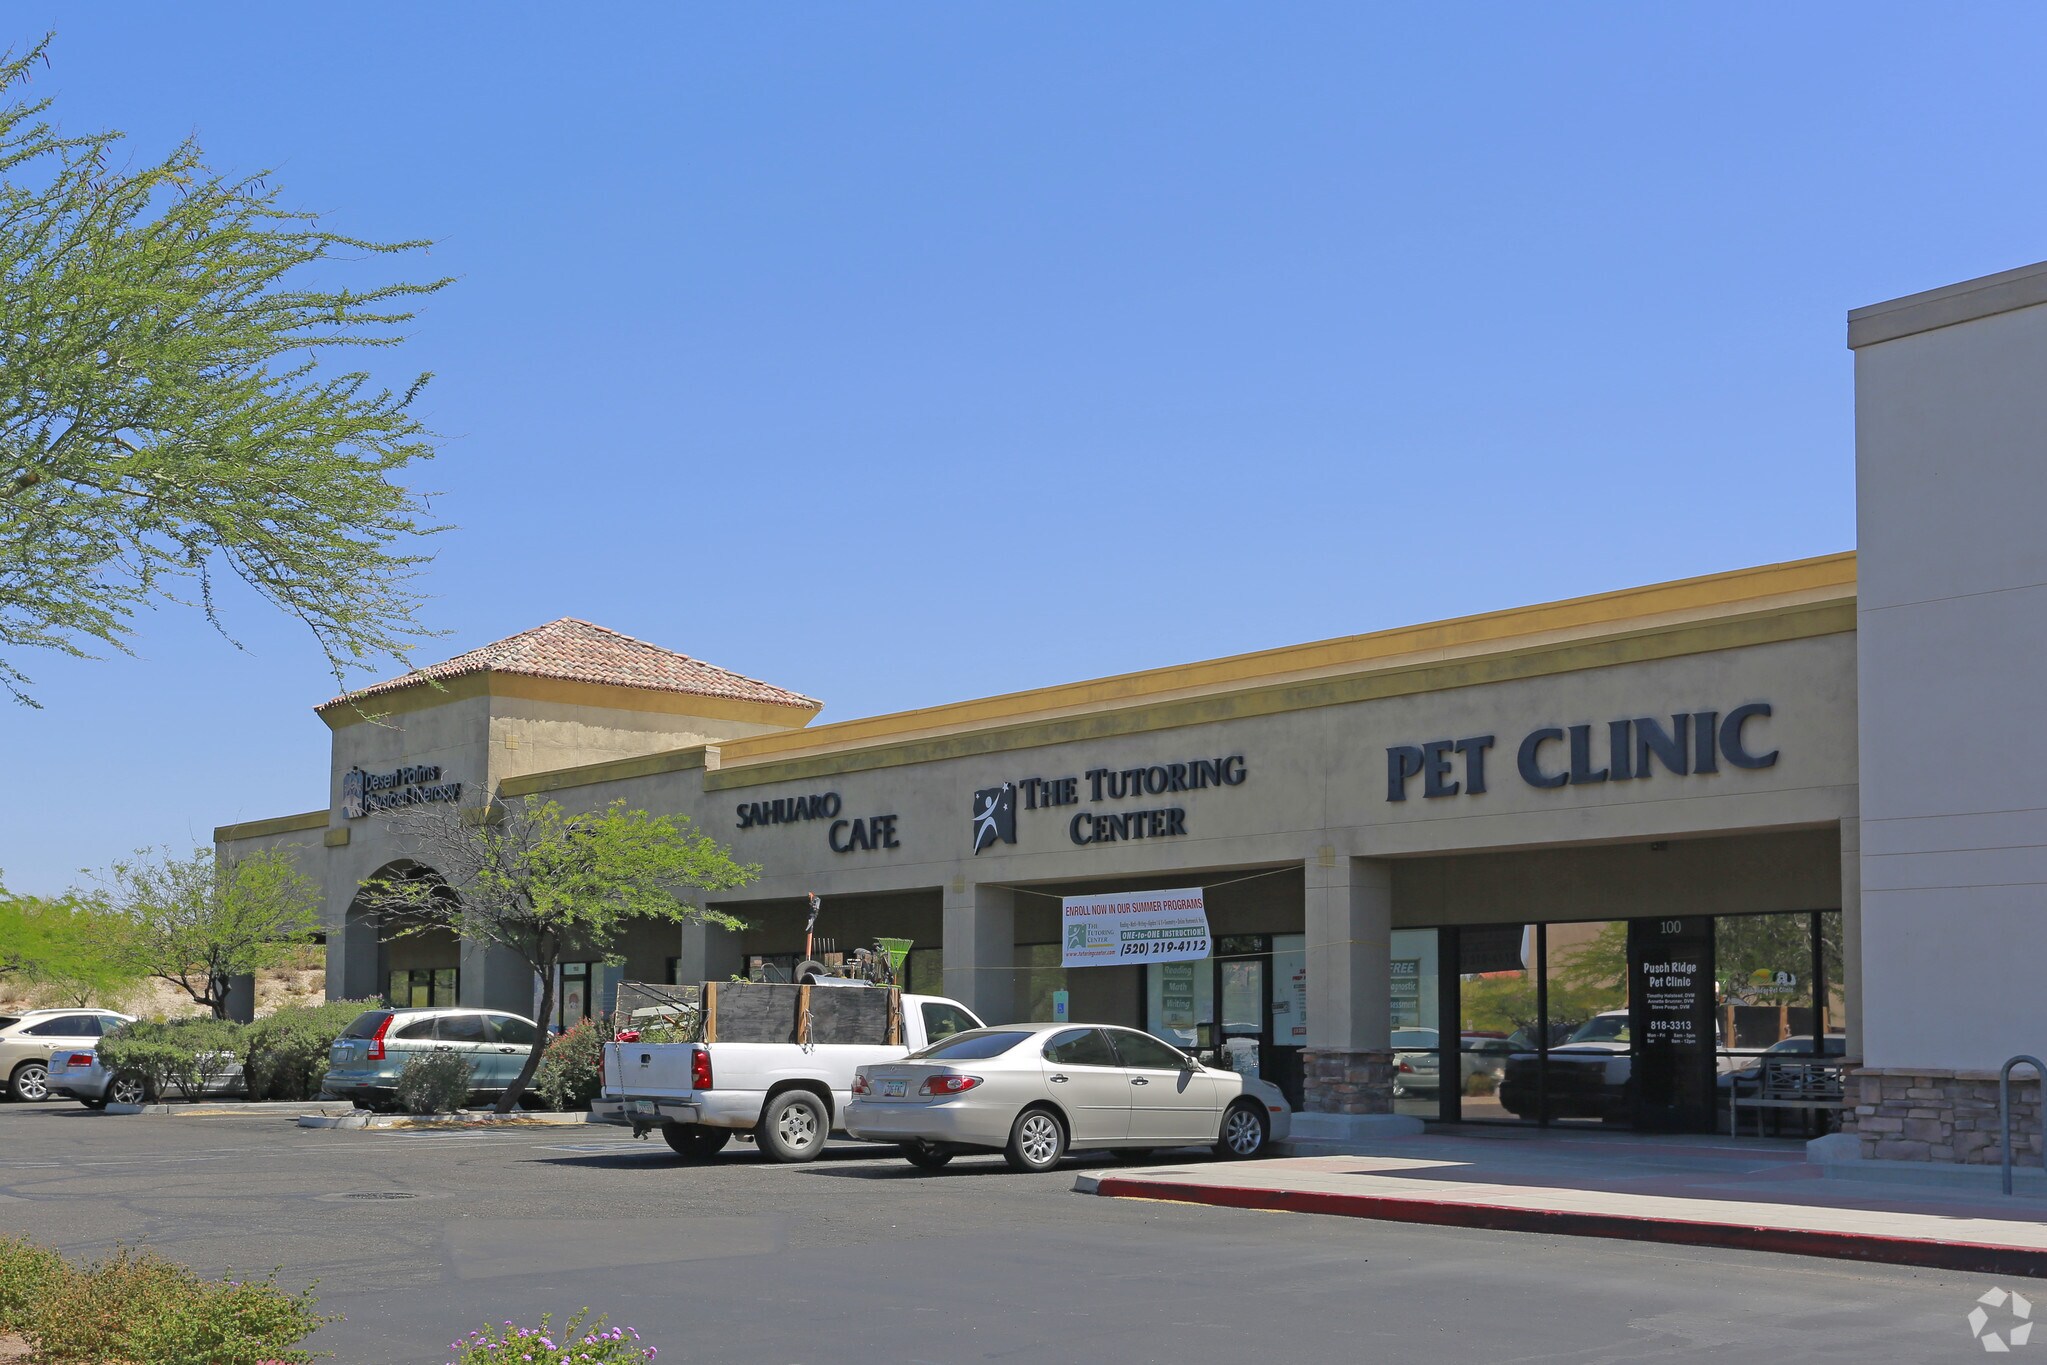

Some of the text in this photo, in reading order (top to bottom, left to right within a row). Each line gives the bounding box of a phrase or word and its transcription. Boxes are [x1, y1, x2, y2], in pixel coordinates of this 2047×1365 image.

[1386, 703, 1780, 802] PET CLINIC
[364, 765, 440, 791] Desert Palms
[1019, 755, 1247, 810] THE TUTORING
[364, 783, 461, 811] Physical Therapy
[736, 791, 842, 829] SAHUARO
[828, 813, 900, 854] CAFE
[1069, 807, 1187, 846] CENTER
[1065, 898, 1203, 917] ENROLL NOW IN OUR SUMMER PROGRAMS
[1660, 920, 1682, 934] 100
[1120, 940, 1207, 957] (520) 219-4112
[1164, 965, 1192, 976] Reading
[1643, 962, 1697, 974] Pusch Ridge
[1168, 982, 1187, 991] Math
[1390, 982, 1416, 992] agnostic
[1649, 976, 1691, 987] Pet Clinic
[1166, 999, 1190, 1009] Writing
[1650, 1020, 1692, 1030] 818-3313
